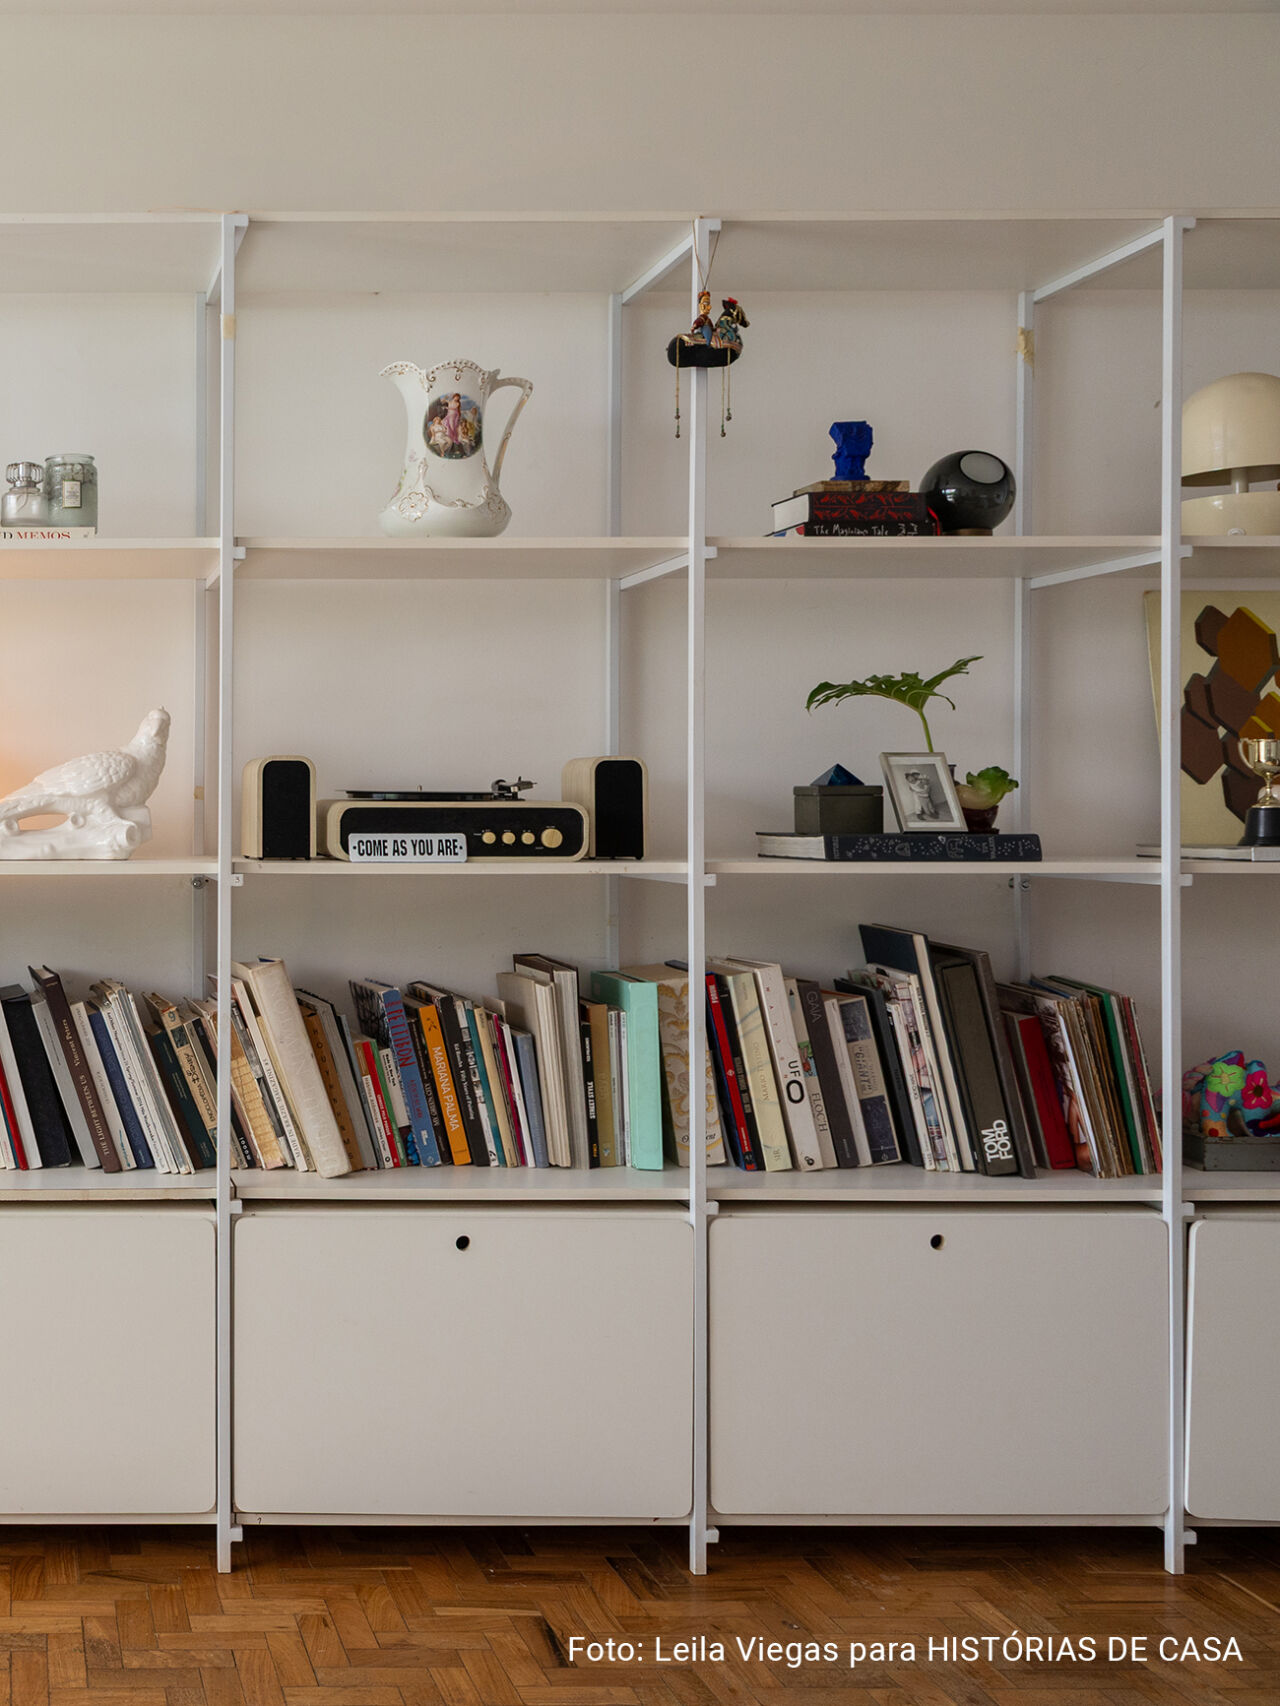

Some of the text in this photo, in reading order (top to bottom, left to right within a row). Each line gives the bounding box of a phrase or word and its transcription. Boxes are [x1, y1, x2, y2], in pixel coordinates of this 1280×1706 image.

[17, 531, 70, 539] MEMOS
[814, 525, 829, 535] The
[358, 839, 459, 856] COME AS YOU ARE
[167, 1011, 176, 1022] 9
[807, 991, 822, 1023] GAIA
[62, 1019, 81, 1066] Vincent Peters
[387, 1008, 416, 1068] PETTIBON
[265, 1067, 281, 1104] MAGAZINE
[432, 1046, 461, 1132] MARIANA PALMA
[454, 1043, 460, 1051] Ed
[466, 1100, 475, 1120] Painting
[586, 1081, 596, 1119] STREET STYLE
[786, 1060, 805, 1104] UFO
[80, 1074, 110, 1156] THE LIGHT BETWEEN US
[279, 1104, 292, 1128] BRAZIL
[424, 1082, 440, 1126] MY GREEN CITY
[812, 1092, 828, 1132] FLOC'H
[287, 1128, 294, 1136] IN
[290, 1137, 301, 1158] MADE
[980, 1128, 996, 1163] TOM
[992, 1119, 1014, 1160] FORD
